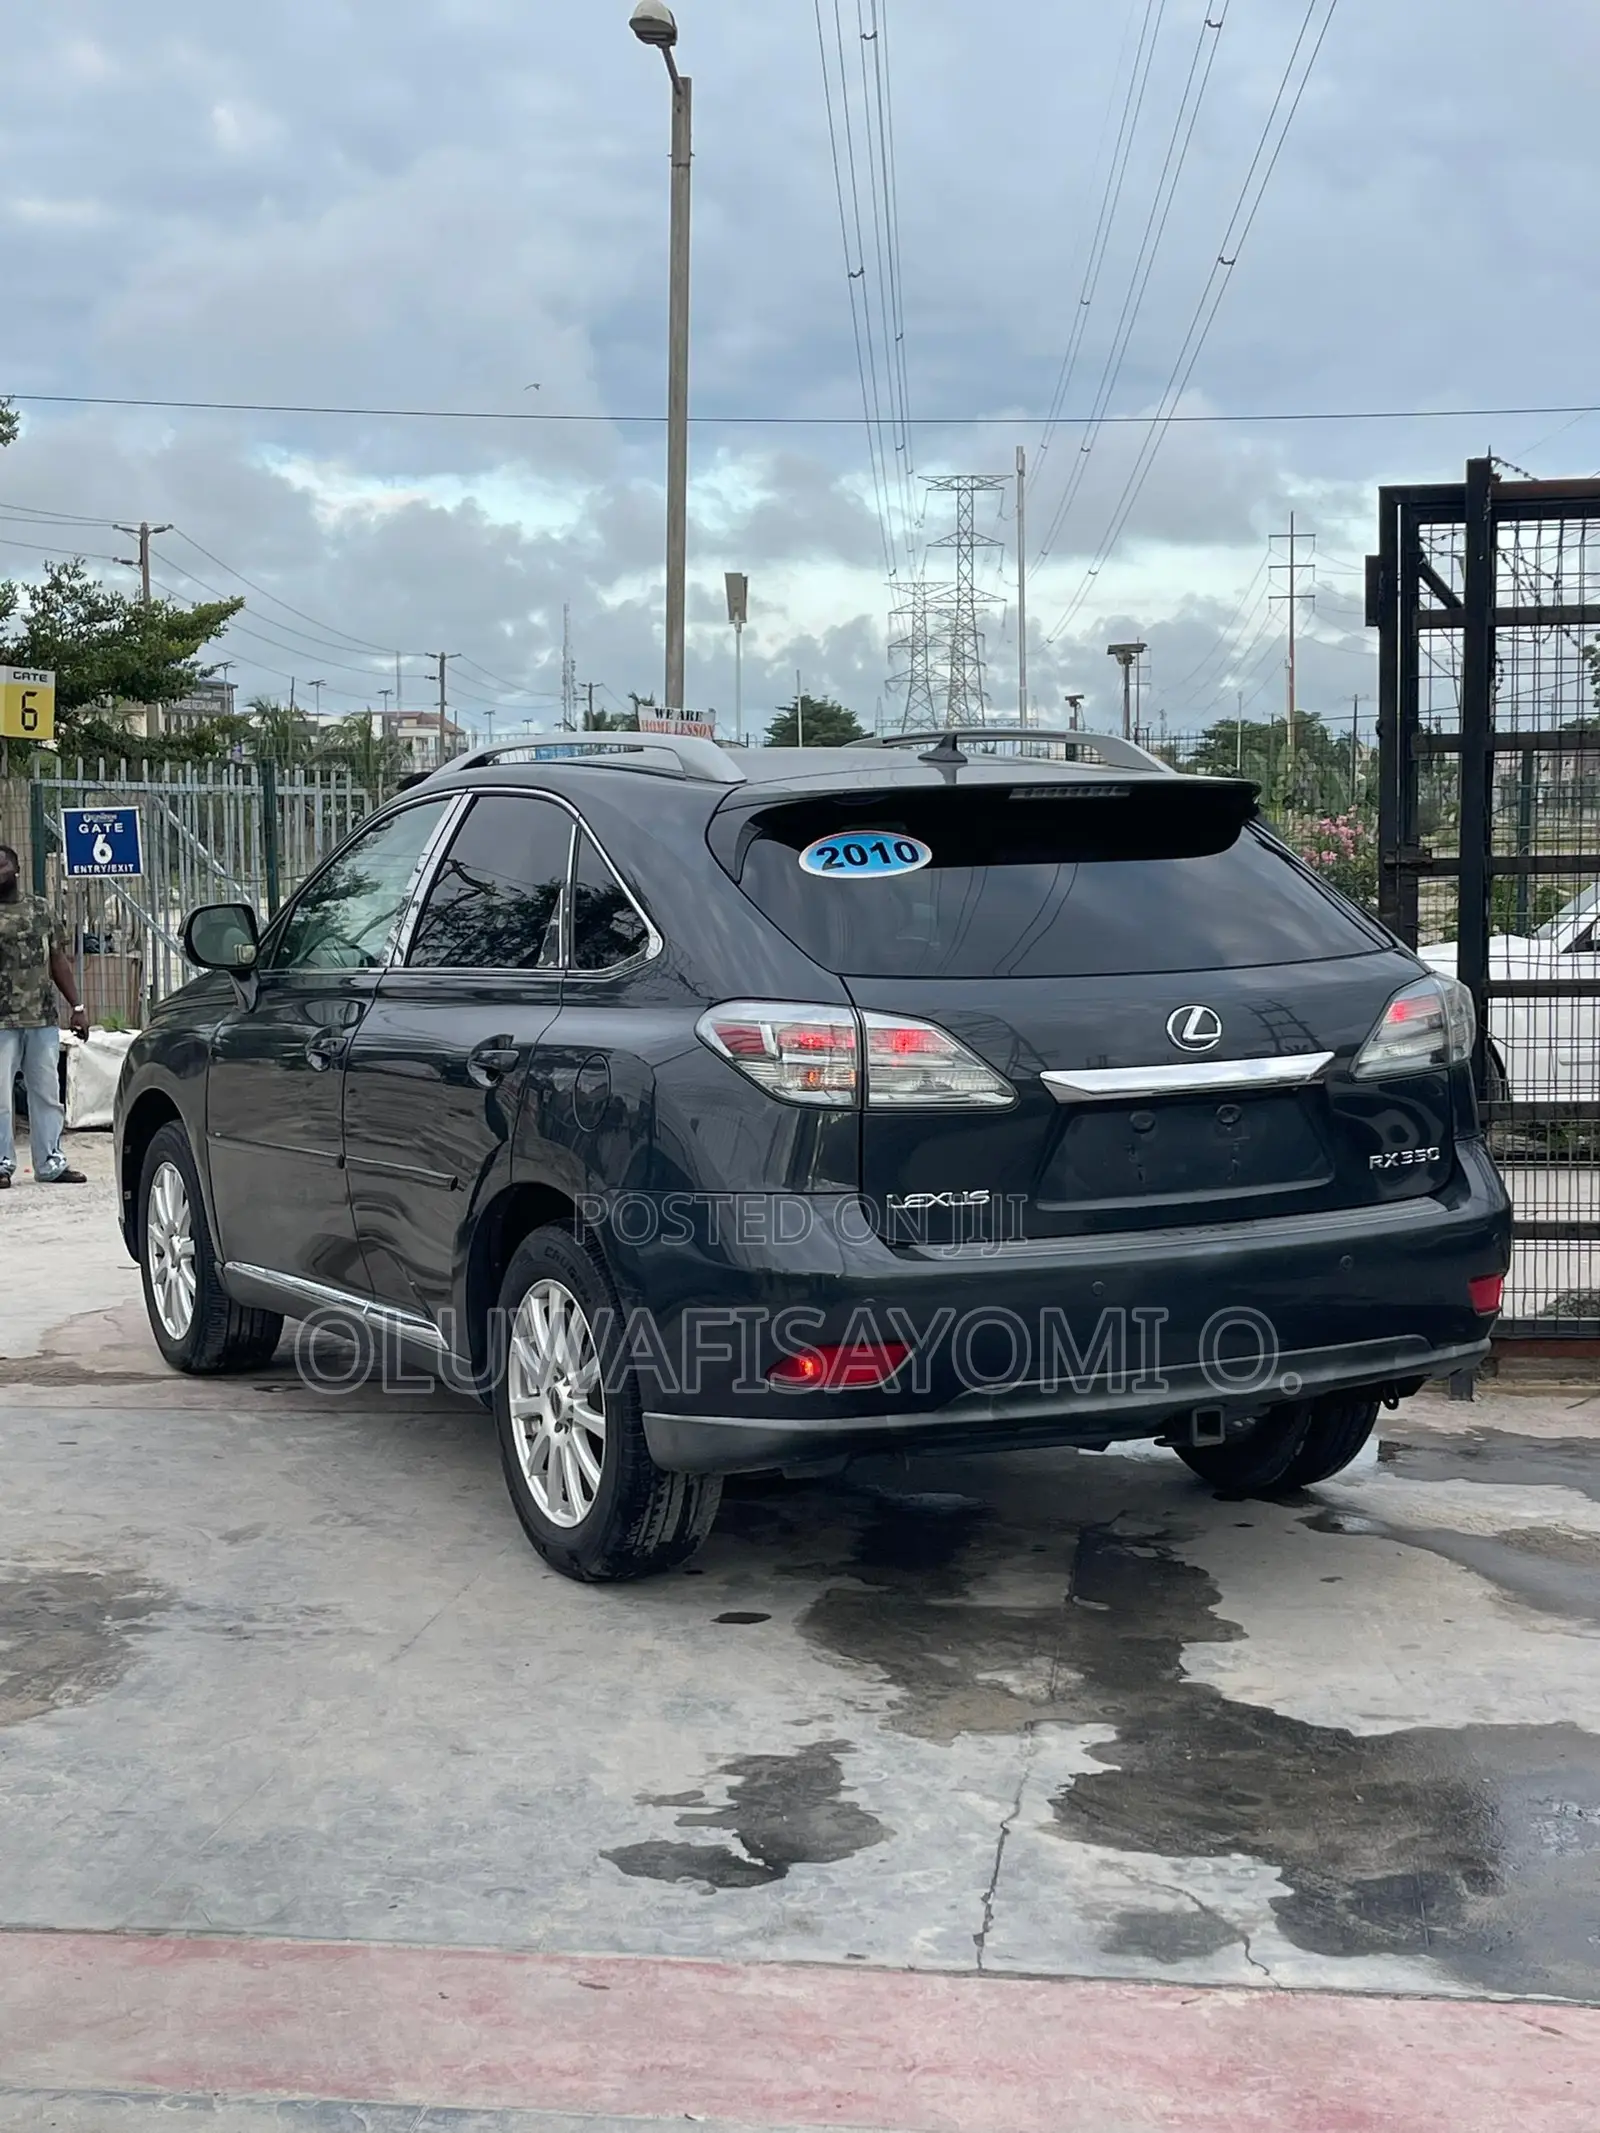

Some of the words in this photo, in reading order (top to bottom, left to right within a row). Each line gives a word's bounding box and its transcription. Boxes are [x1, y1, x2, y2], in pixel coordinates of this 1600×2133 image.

[13, 671, 48, 683] GATE
[21, 690, 38, 731] 6
[655, 708, 673, 719] WE
[678, 710, 703, 722] ARE
[640, 719, 672, 734] HOME
[79, 823, 124, 834] GATE
[93, 834, 113, 864] 6
[816, 841, 920, 871] 2010
[74, 864, 134, 874] ENTRY/EXIT
[1369, 1147, 1440, 1170] RX350
[886, 1190, 990, 1209] LEXUS
